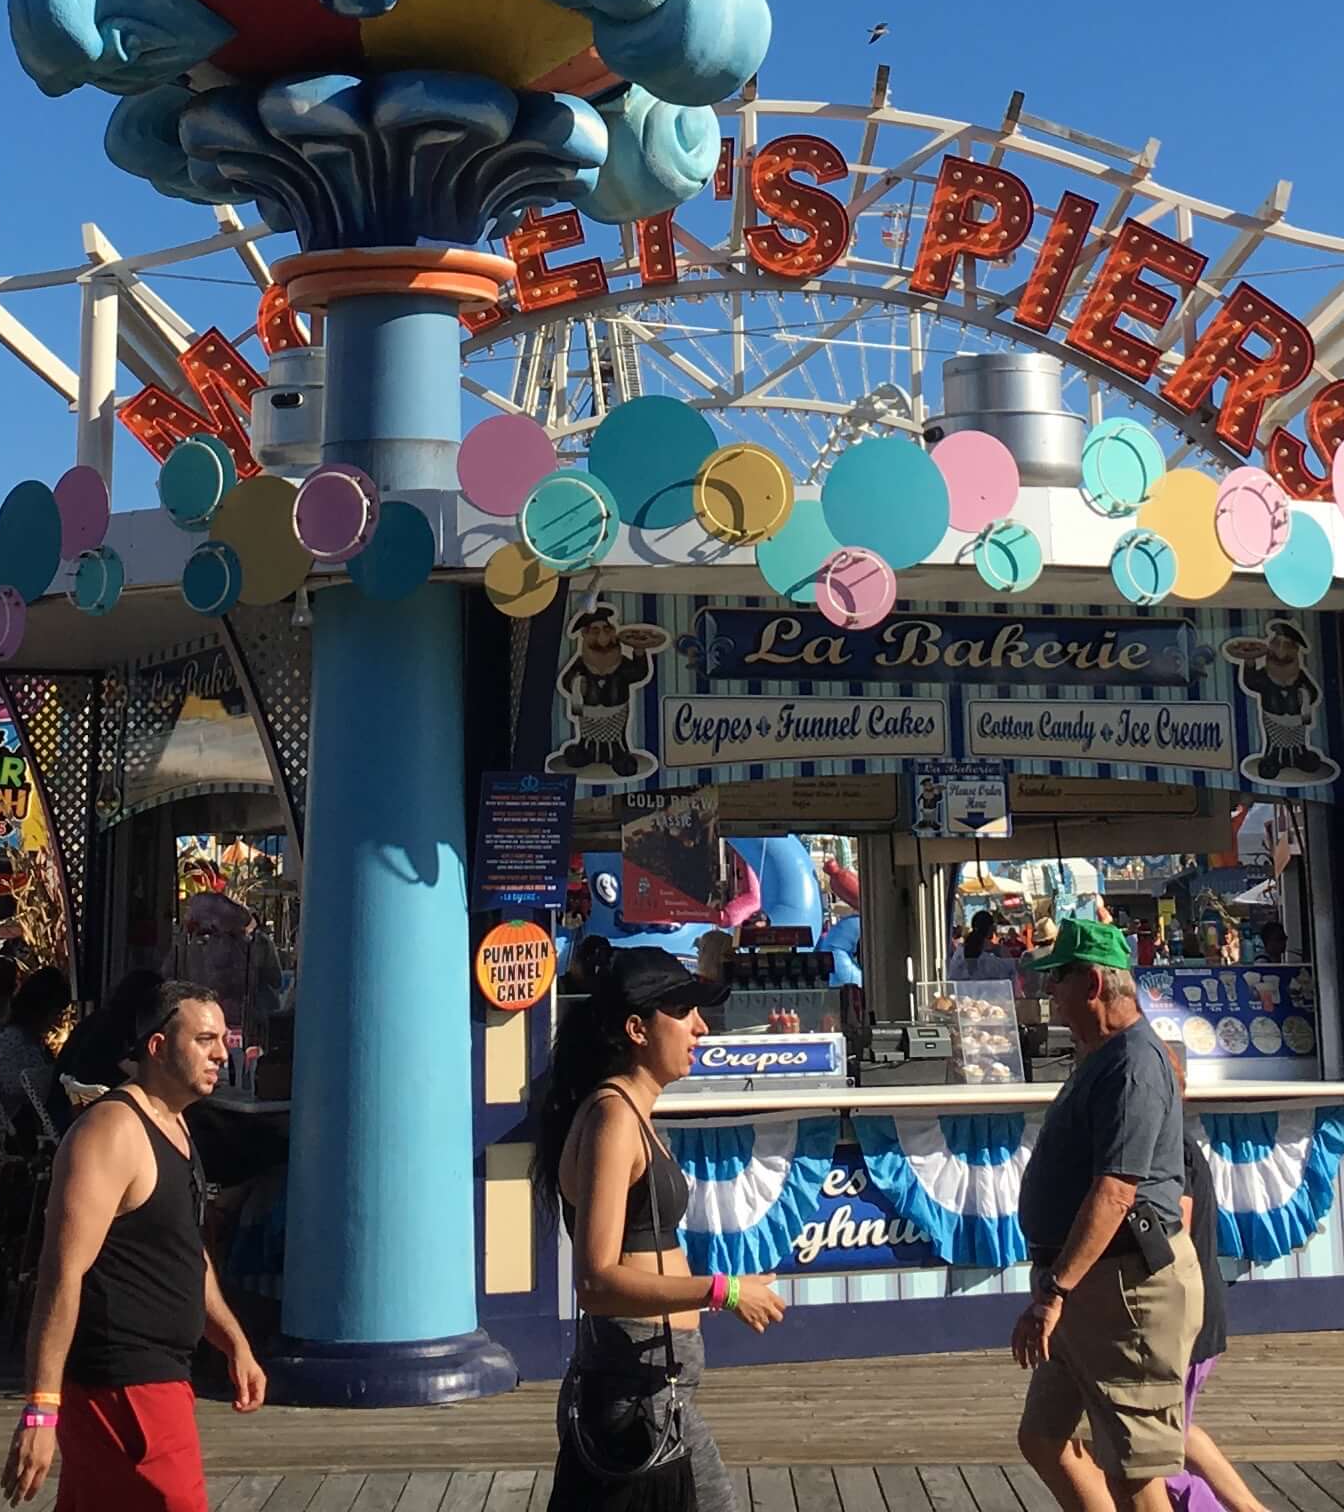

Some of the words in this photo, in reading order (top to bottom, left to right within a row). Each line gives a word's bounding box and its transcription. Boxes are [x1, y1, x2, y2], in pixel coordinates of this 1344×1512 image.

[744, 618, 852, 666] La
[874, 619, 1152, 672] Bakerie
[674, 707, 753, 755] Crepes
[775, 704, 861, 741] Funnel
[867, 705, 937, 737] Cakes
[977, 712, 1034, 740] Cotton
[1038, 710, 1095, 749] Candy
[1115, 710, 1152, 744] Ice
[1155, 713, 1224, 749] Cream
[627, 793, 665, 808] COLD
[482, 941, 550, 963] PUMPKIN
[490, 962, 542, 983] FUNNEL
[496, 982, 536, 1002] CAKE
[701, 1047, 808, 1072] Crepes
[791, 1204, 931, 1264] ghnu
